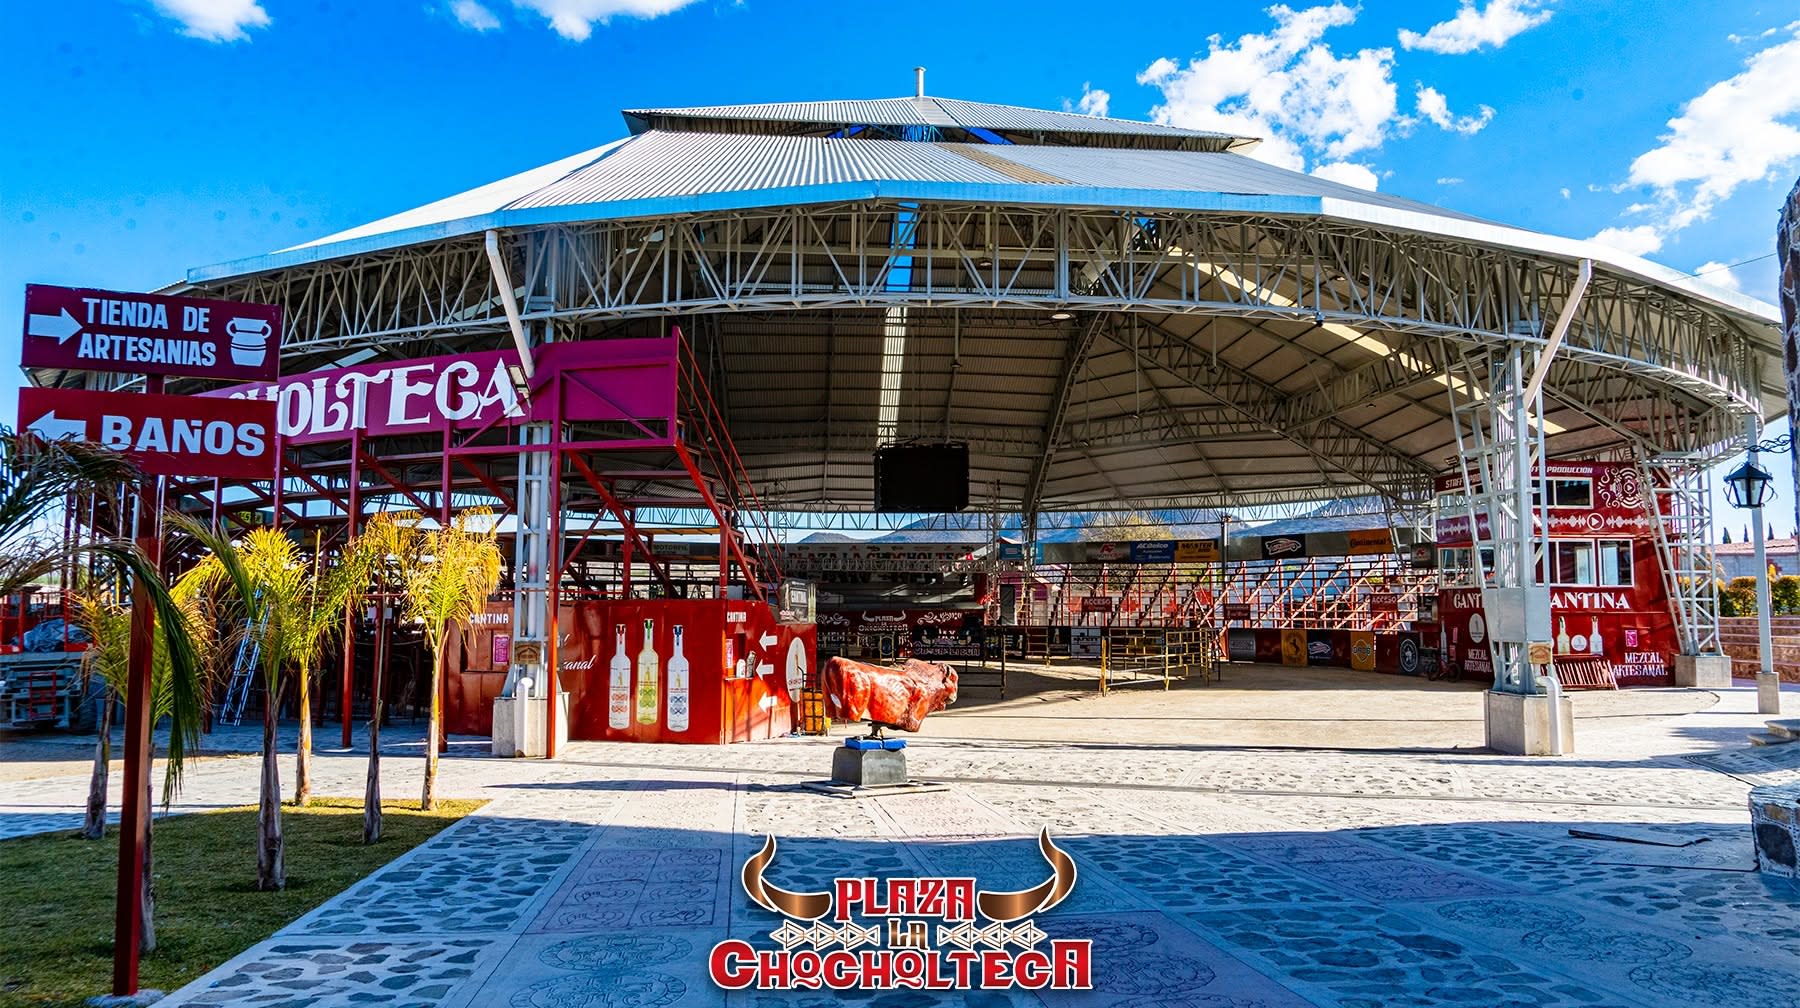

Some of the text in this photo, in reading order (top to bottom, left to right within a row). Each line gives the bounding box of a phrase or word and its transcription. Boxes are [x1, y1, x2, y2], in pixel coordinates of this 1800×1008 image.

[81, 297, 210, 333] TIENDA DE
[77, 332, 217, 367] ARTESANIAS
[229, 357, 526, 436] OLTECA
[101, 415, 265, 457] BAÑOS
[1453, 593, 1482, 608] CANT
[1551, 592, 1631, 609] ANTINA
[1625, 652, 1663, 664] MEZCAL
